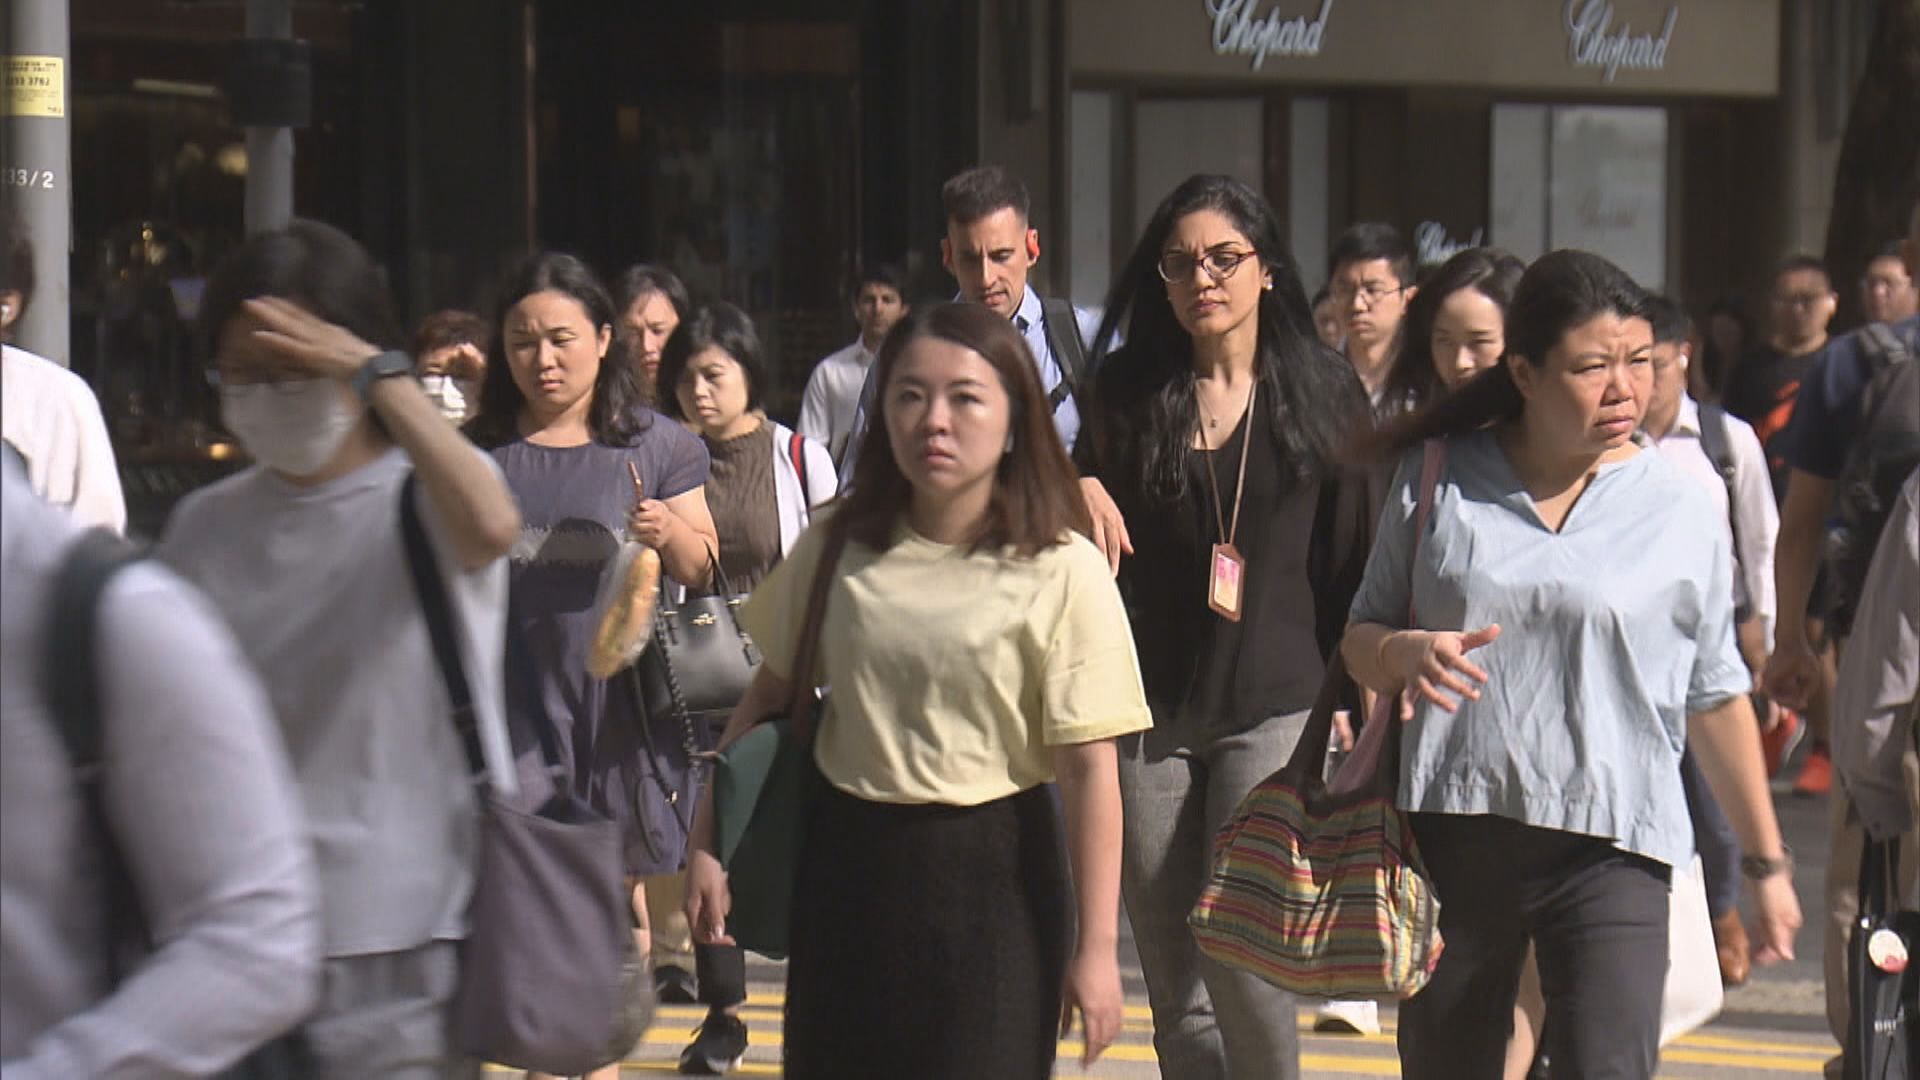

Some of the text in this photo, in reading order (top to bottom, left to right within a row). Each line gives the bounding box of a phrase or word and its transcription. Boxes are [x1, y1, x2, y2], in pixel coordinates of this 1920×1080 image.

[1204, 0, 1333, 71] Chopard
[1563, 0, 1678, 82] Chopard
[1415, 220, 1483, 263] Chop
